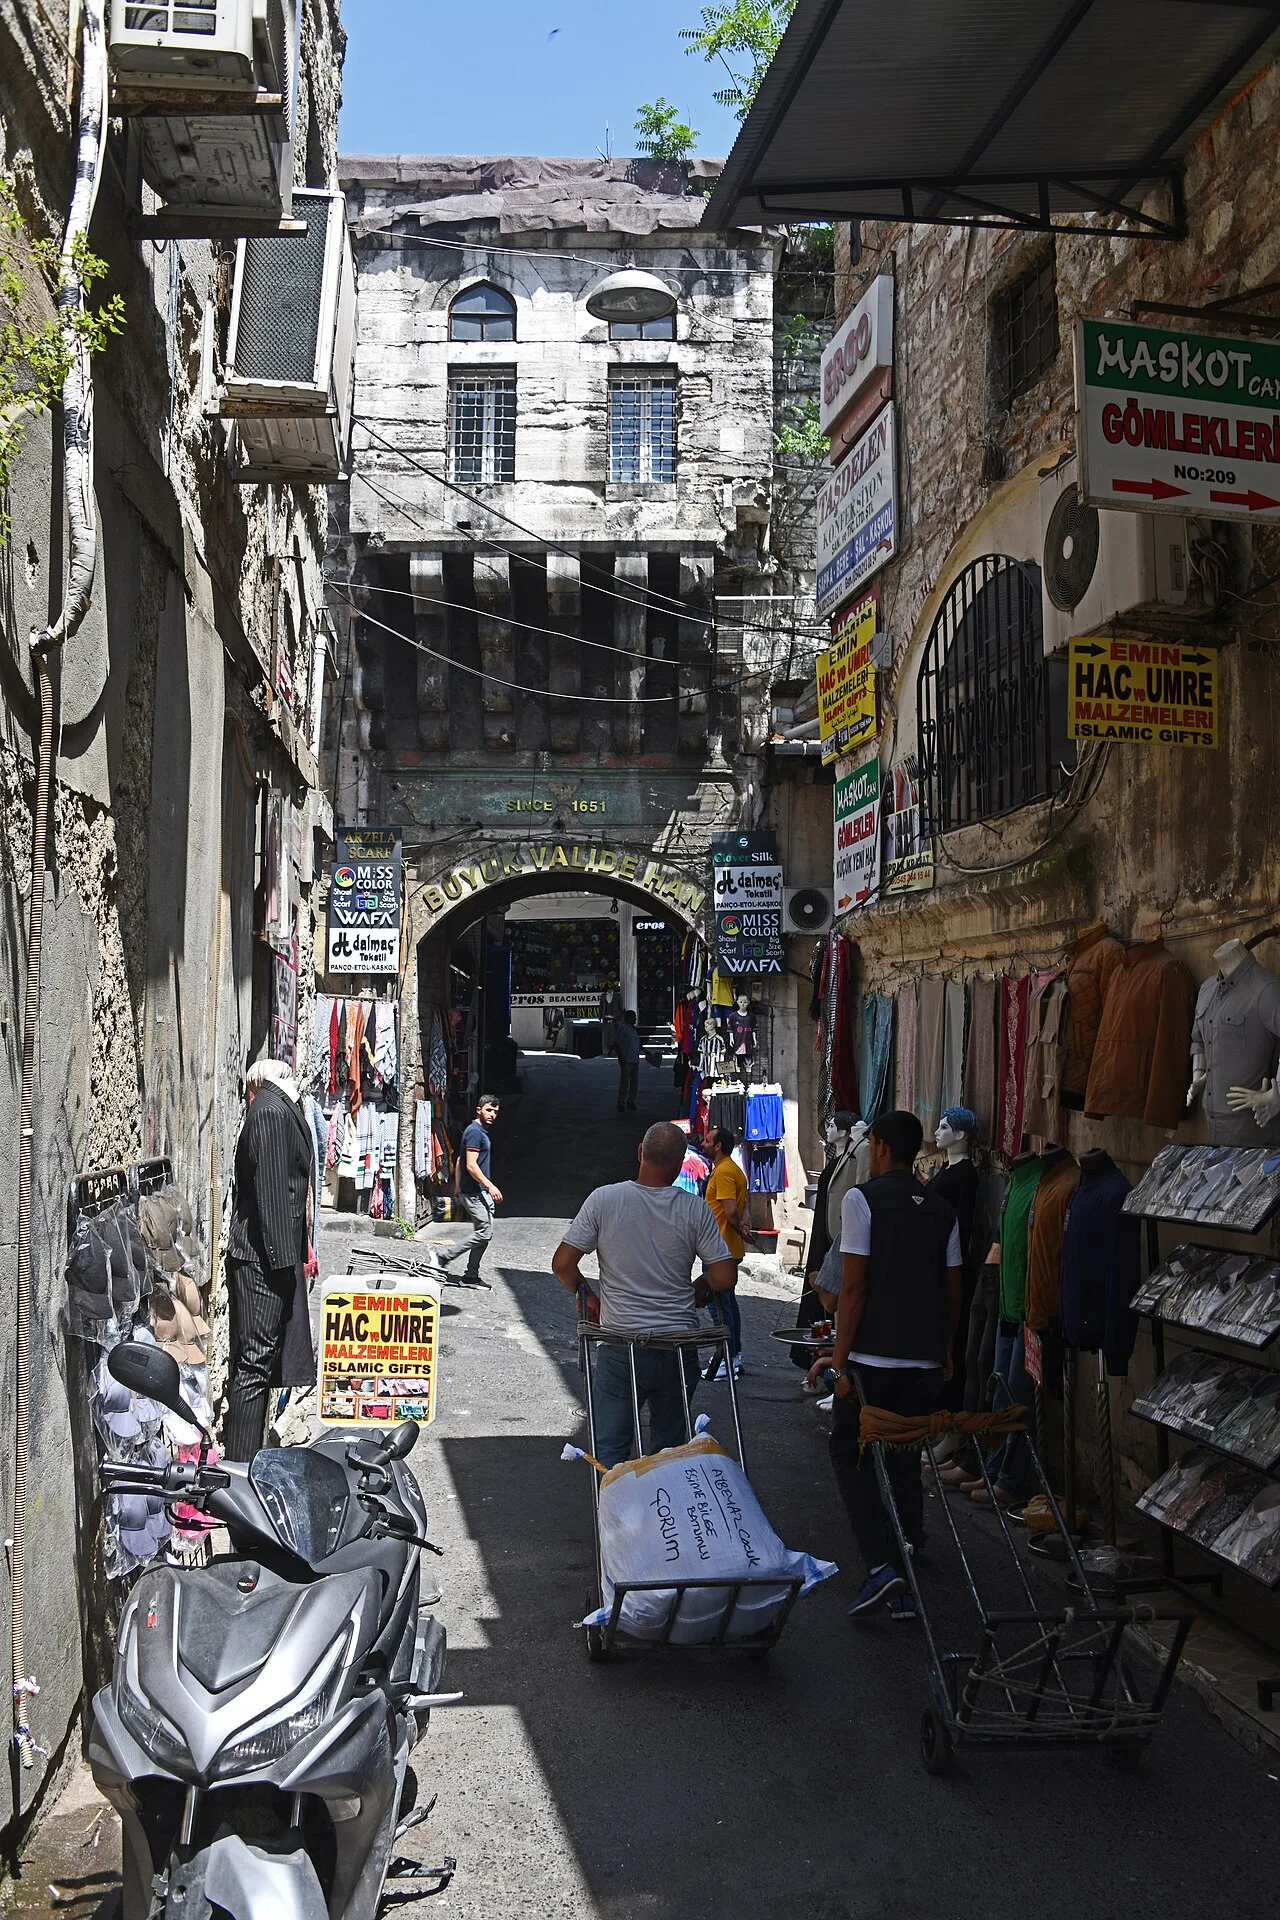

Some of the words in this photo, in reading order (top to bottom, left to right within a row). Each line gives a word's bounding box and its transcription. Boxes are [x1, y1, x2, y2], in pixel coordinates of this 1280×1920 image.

[1096, 333, 1252, 390] MASKOT
[819, 414, 888, 527] TAŞDELEN
[1173, 464, 1236, 486] NO:209
[818, 666, 836, 697] HAC
[1075, 662, 1133, 701] HAC
[1133, 688, 1146, 703] ve
[1146, 667, 1213, 708] UMRE
[836, 773, 868, 815] MASKOT
[507, 799, 553, 813] SINCE
[571, 800, 606, 813] 1651
[344, 831, 397, 844] ARZELA
[348, 846, 392, 859] SCARF
[751, 851, 773, 862] Silk
[356, 879, 393, 890] COLOR
[737, 871, 779, 891] dalmaç
[643, 865, 706, 913] HAN
[745, 889, 773, 899] Tekstil
[636, 921, 666, 930] eros
[742, 913, 779, 927] MISS
[742, 926, 779, 937] COLOR
[353, 933, 394, 955] dalmaç
[719, 947, 737, 955] Scarf
[360, 952, 387, 962] Tekstil
[722, 955, 782, 973] WAFA
[510, 995, 545, 1005] eros
[325, 1312, 370, 1342] HAC
[370, 1331, 380, 1343] ve
[380, 1314, 433, 1344] UMRE
